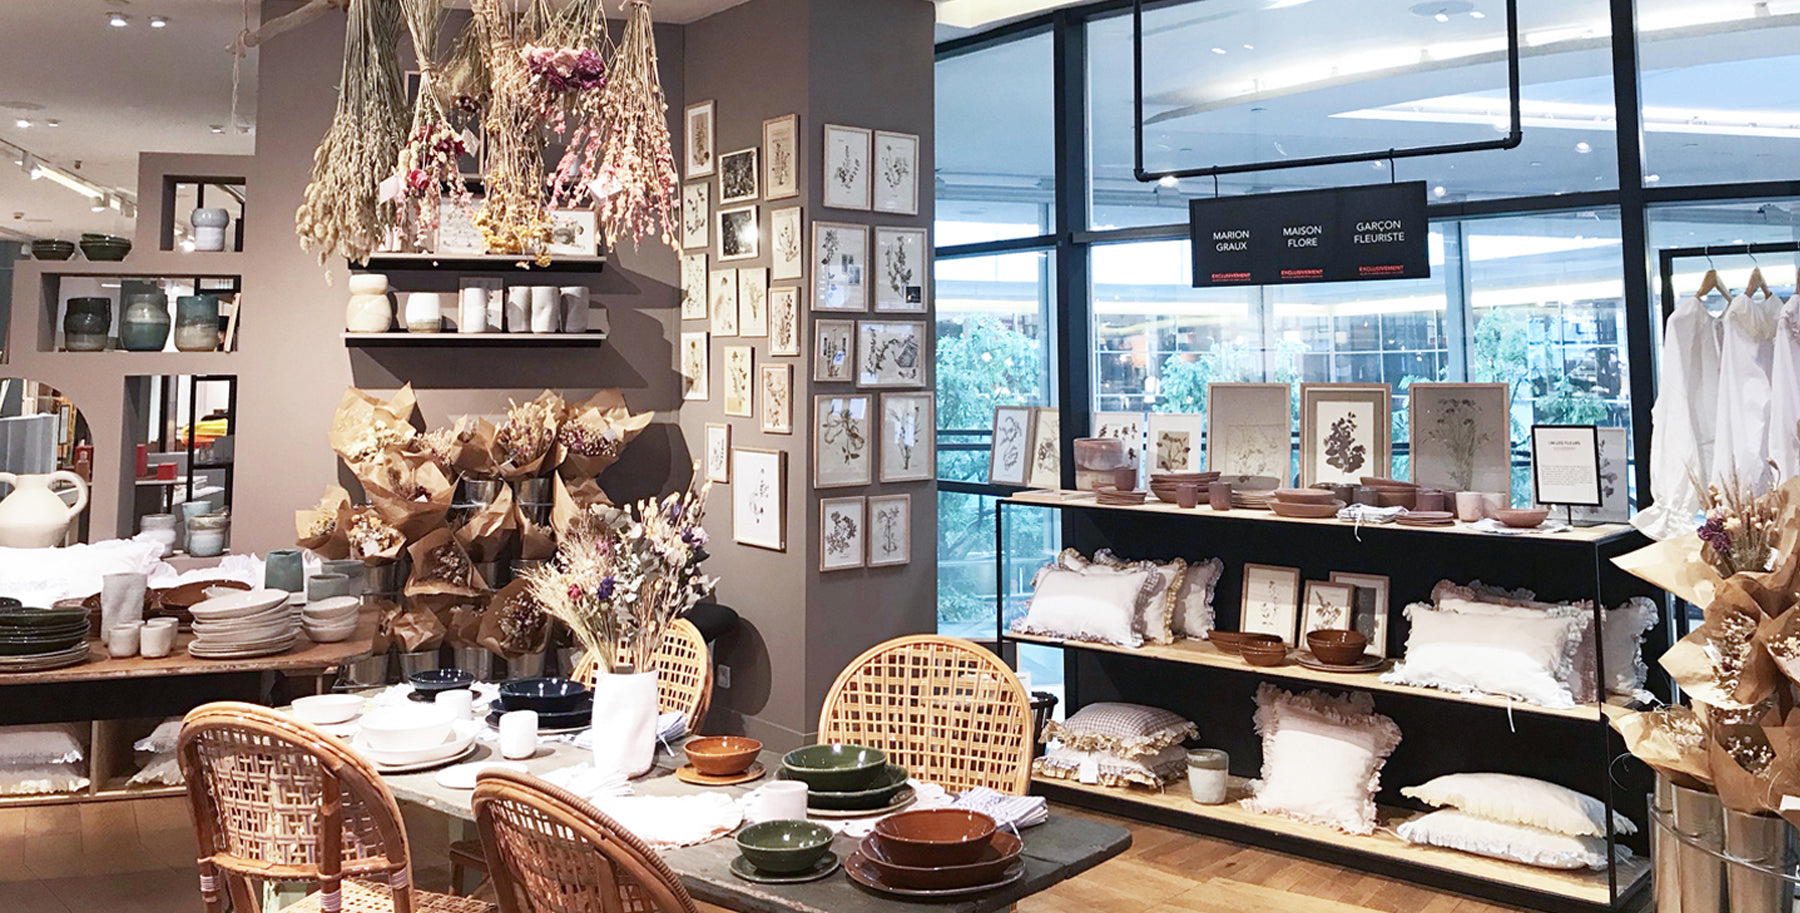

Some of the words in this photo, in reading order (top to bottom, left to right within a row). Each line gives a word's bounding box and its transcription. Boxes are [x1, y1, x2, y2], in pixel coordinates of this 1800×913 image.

[1283, 225, 1322, 237] MAISON
[1356, 220, 1401, 233] GARÇON
[1213, 230, 1250, 241] MARION
[1354, 232, 1405, 244] FLEURISTE
[1216, 242, 1247, 252] GRAUX
[1287, 237, 1318, 248] FLORE
